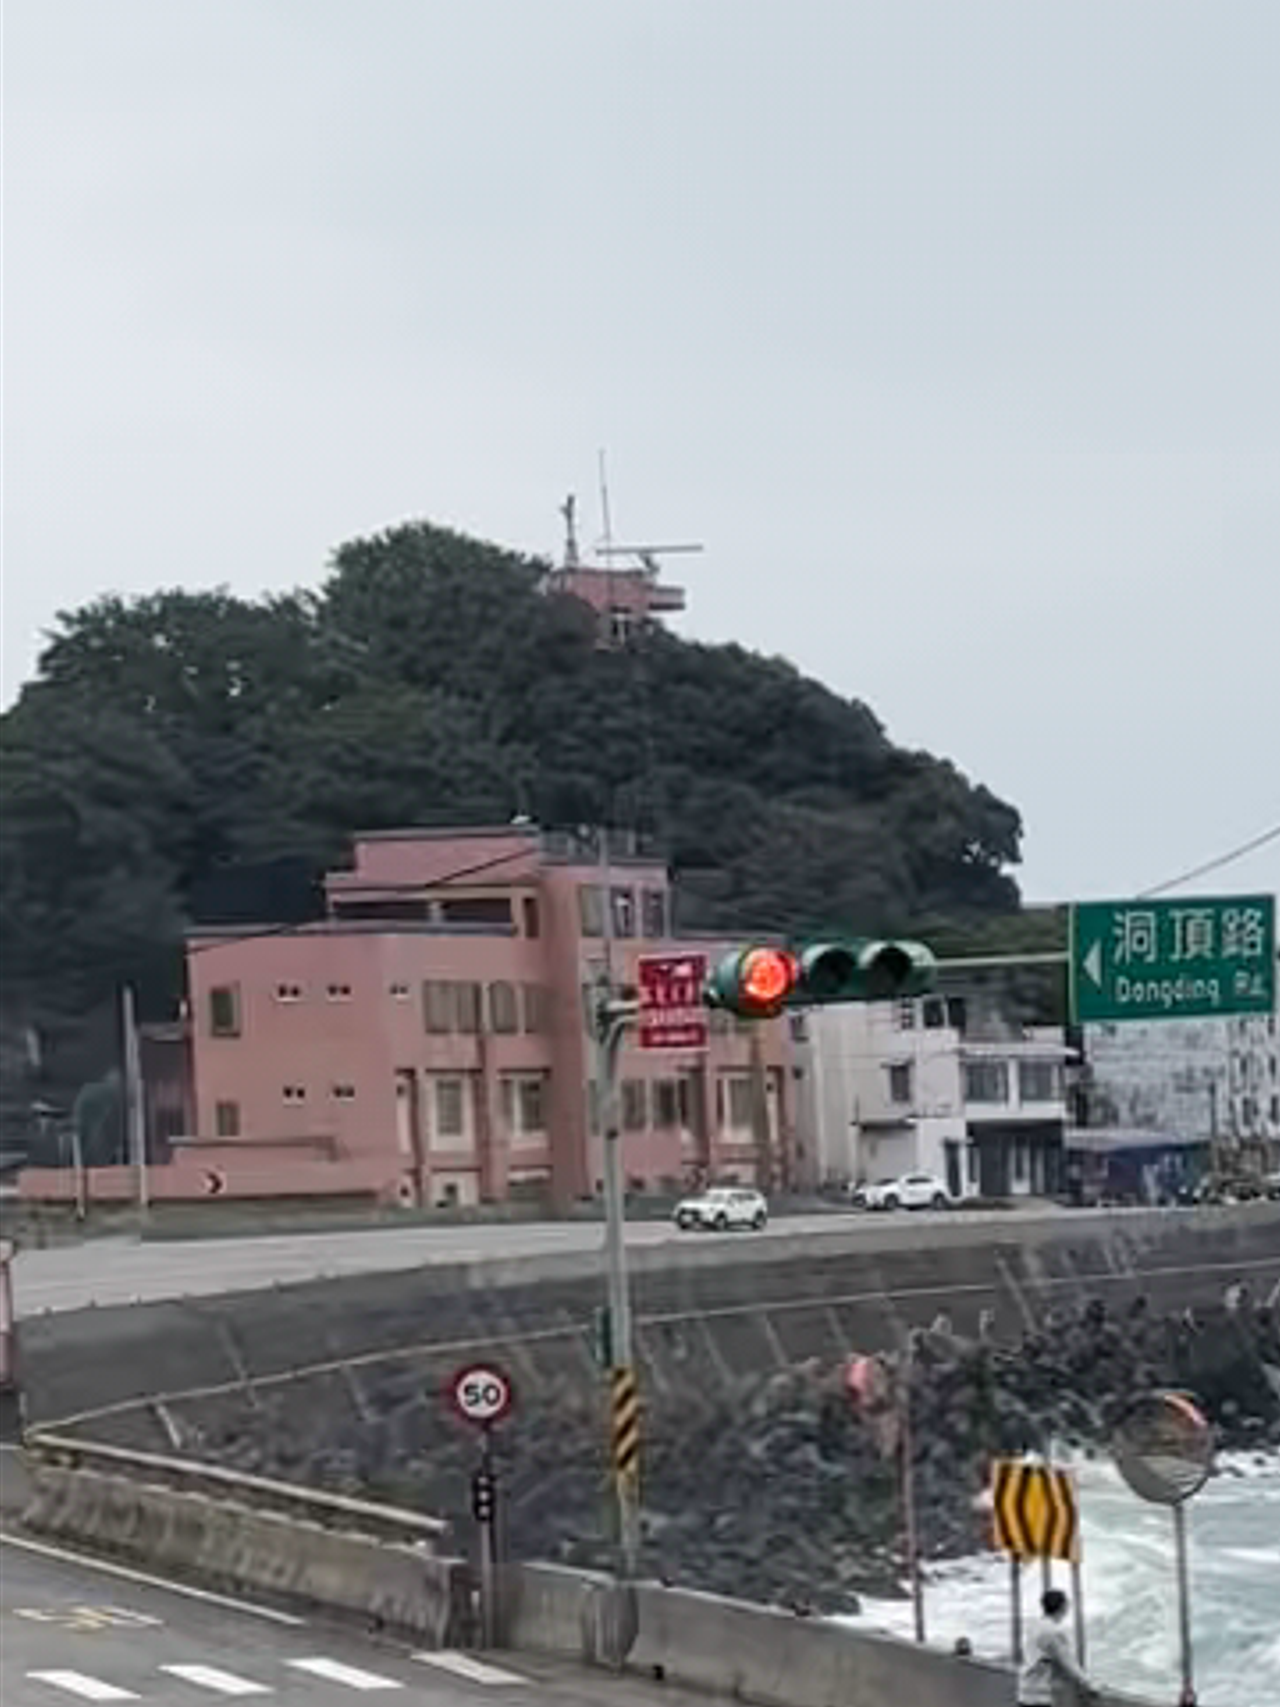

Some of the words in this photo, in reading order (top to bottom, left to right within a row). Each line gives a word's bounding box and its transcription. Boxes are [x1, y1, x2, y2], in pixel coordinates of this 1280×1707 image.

[1113, 908, 1265, 965] 洞頂路
[1115, 975, 1220, 1008] Dongding
[464, 1384, 501, 1407] 50
